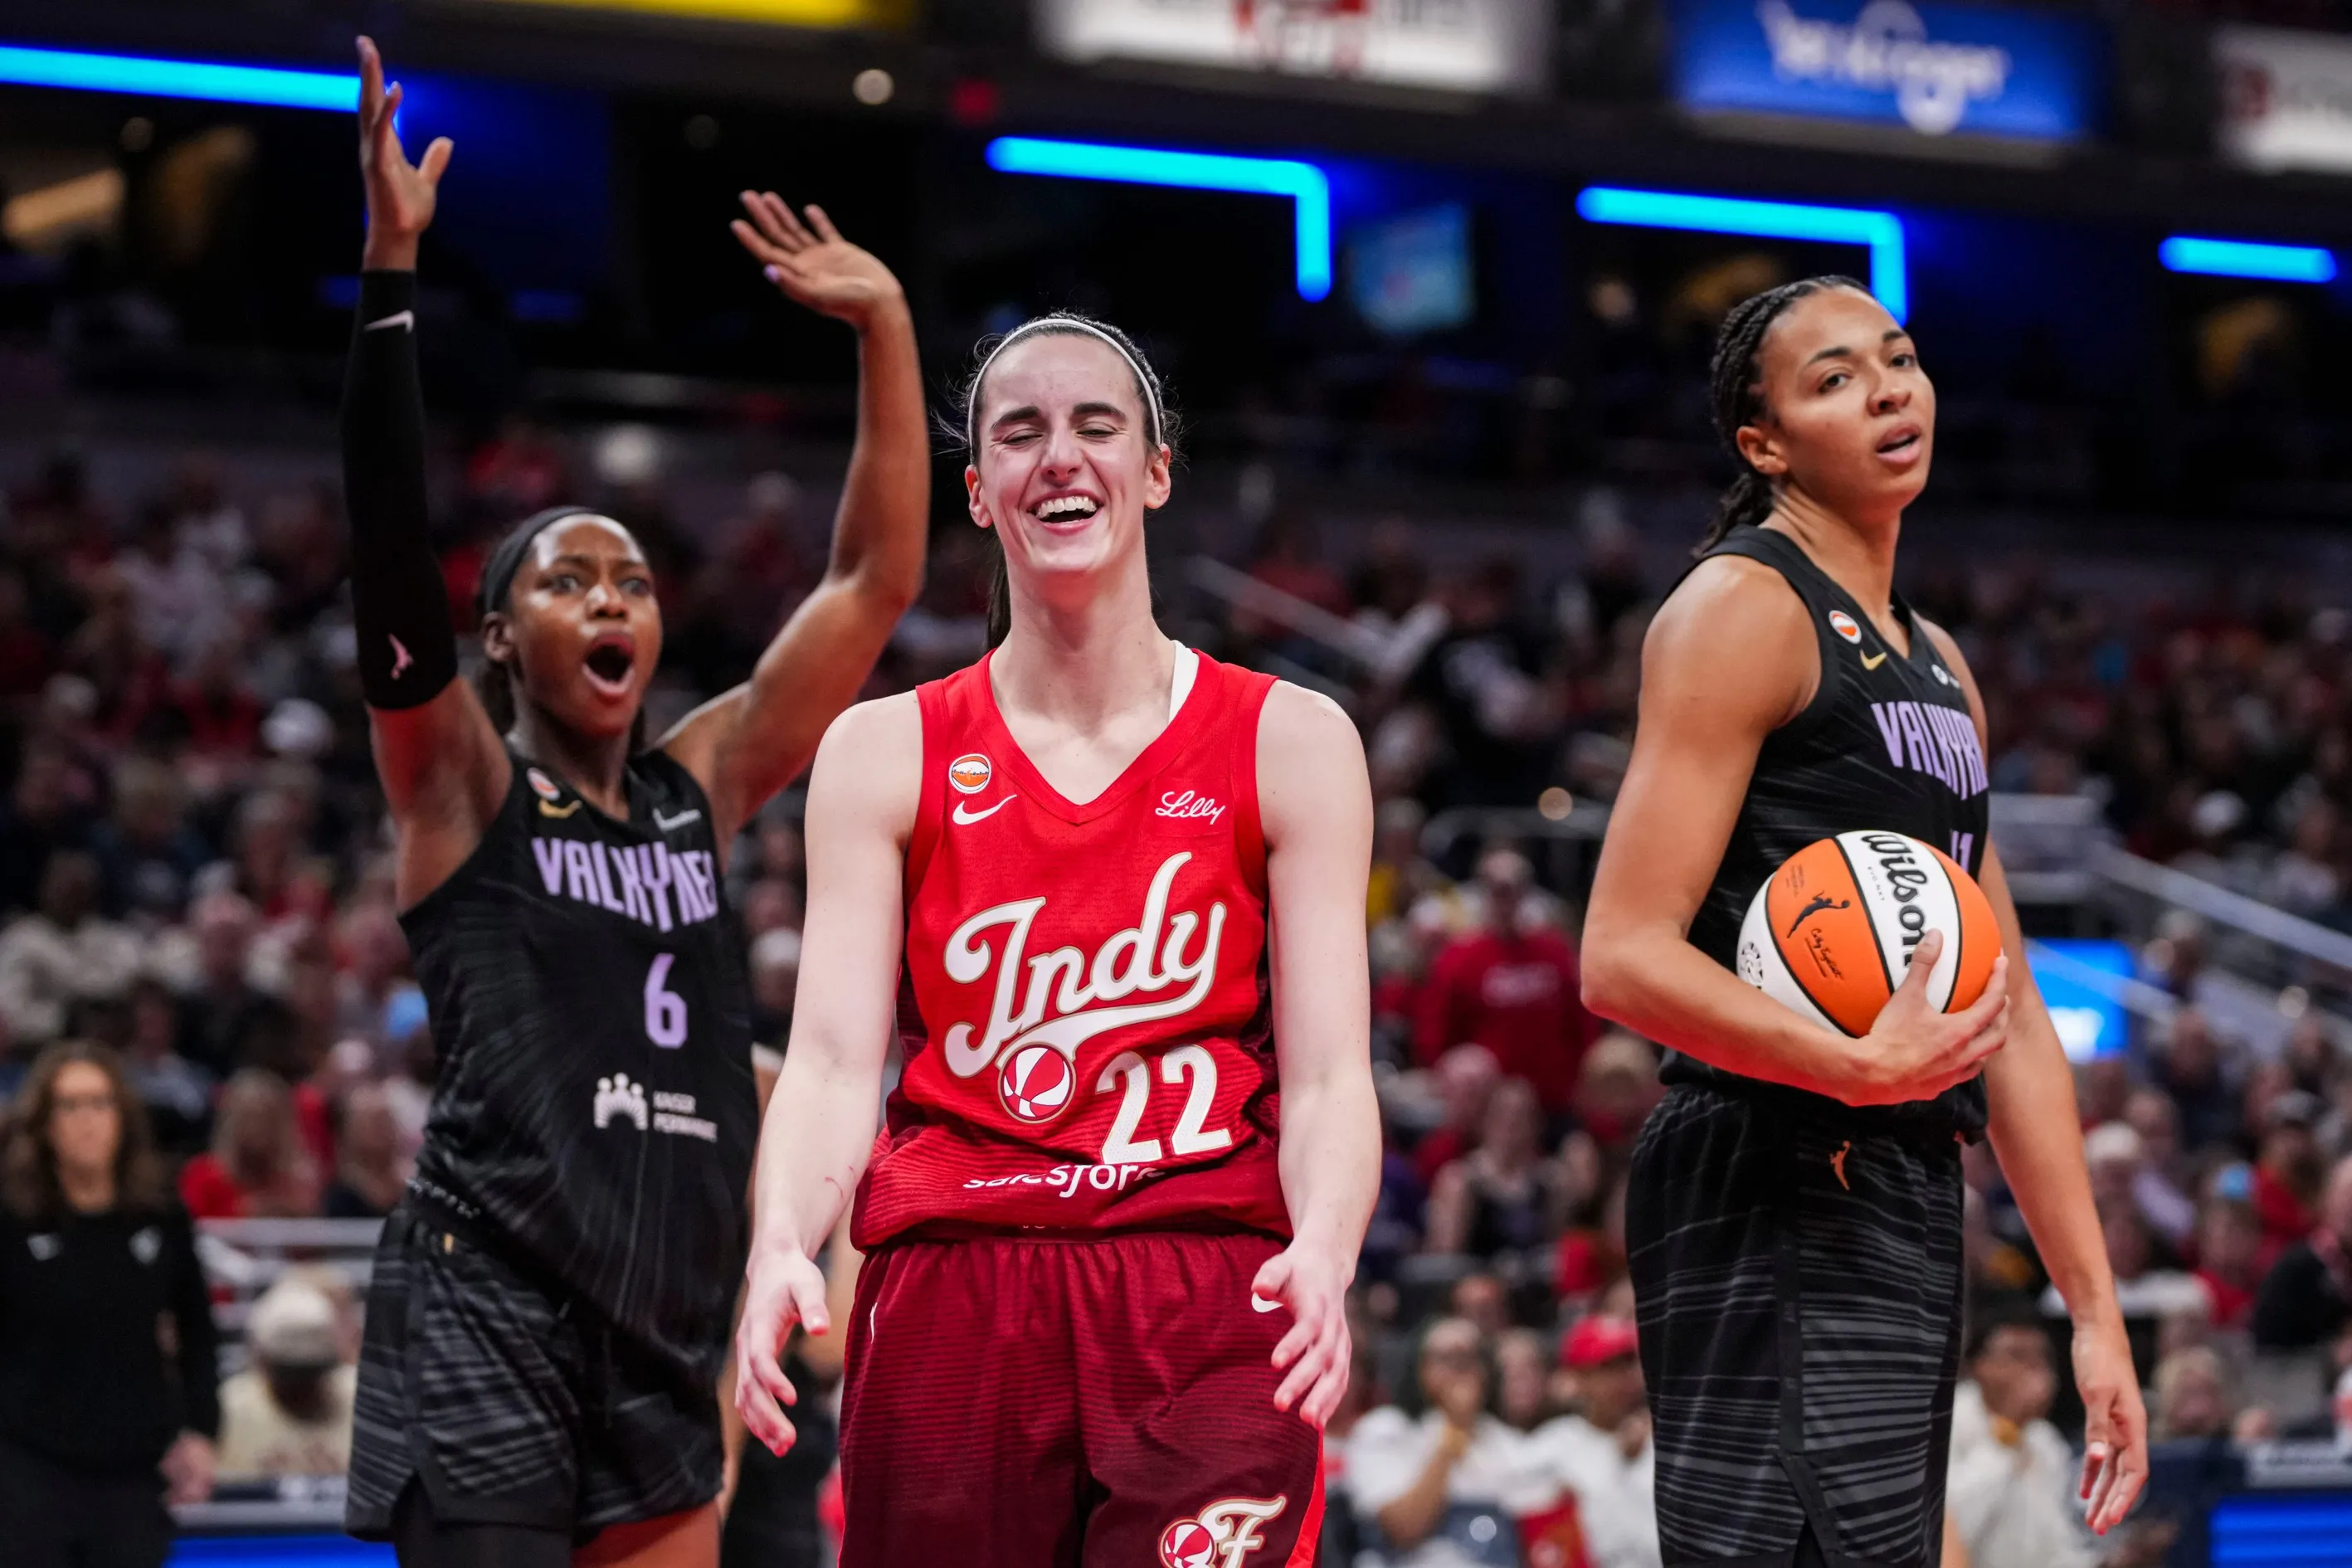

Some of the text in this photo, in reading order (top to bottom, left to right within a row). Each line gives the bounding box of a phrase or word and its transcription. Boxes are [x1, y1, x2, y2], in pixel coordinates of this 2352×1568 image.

[1155, 790, 1225, 825] Lilly
[1861, 834, 1928, 968] Wilson
[643, 952, 688, 1049] 6
[943, 850, 1227, 1078] Indy
[1095, 1043, 1234, 1165] 22
